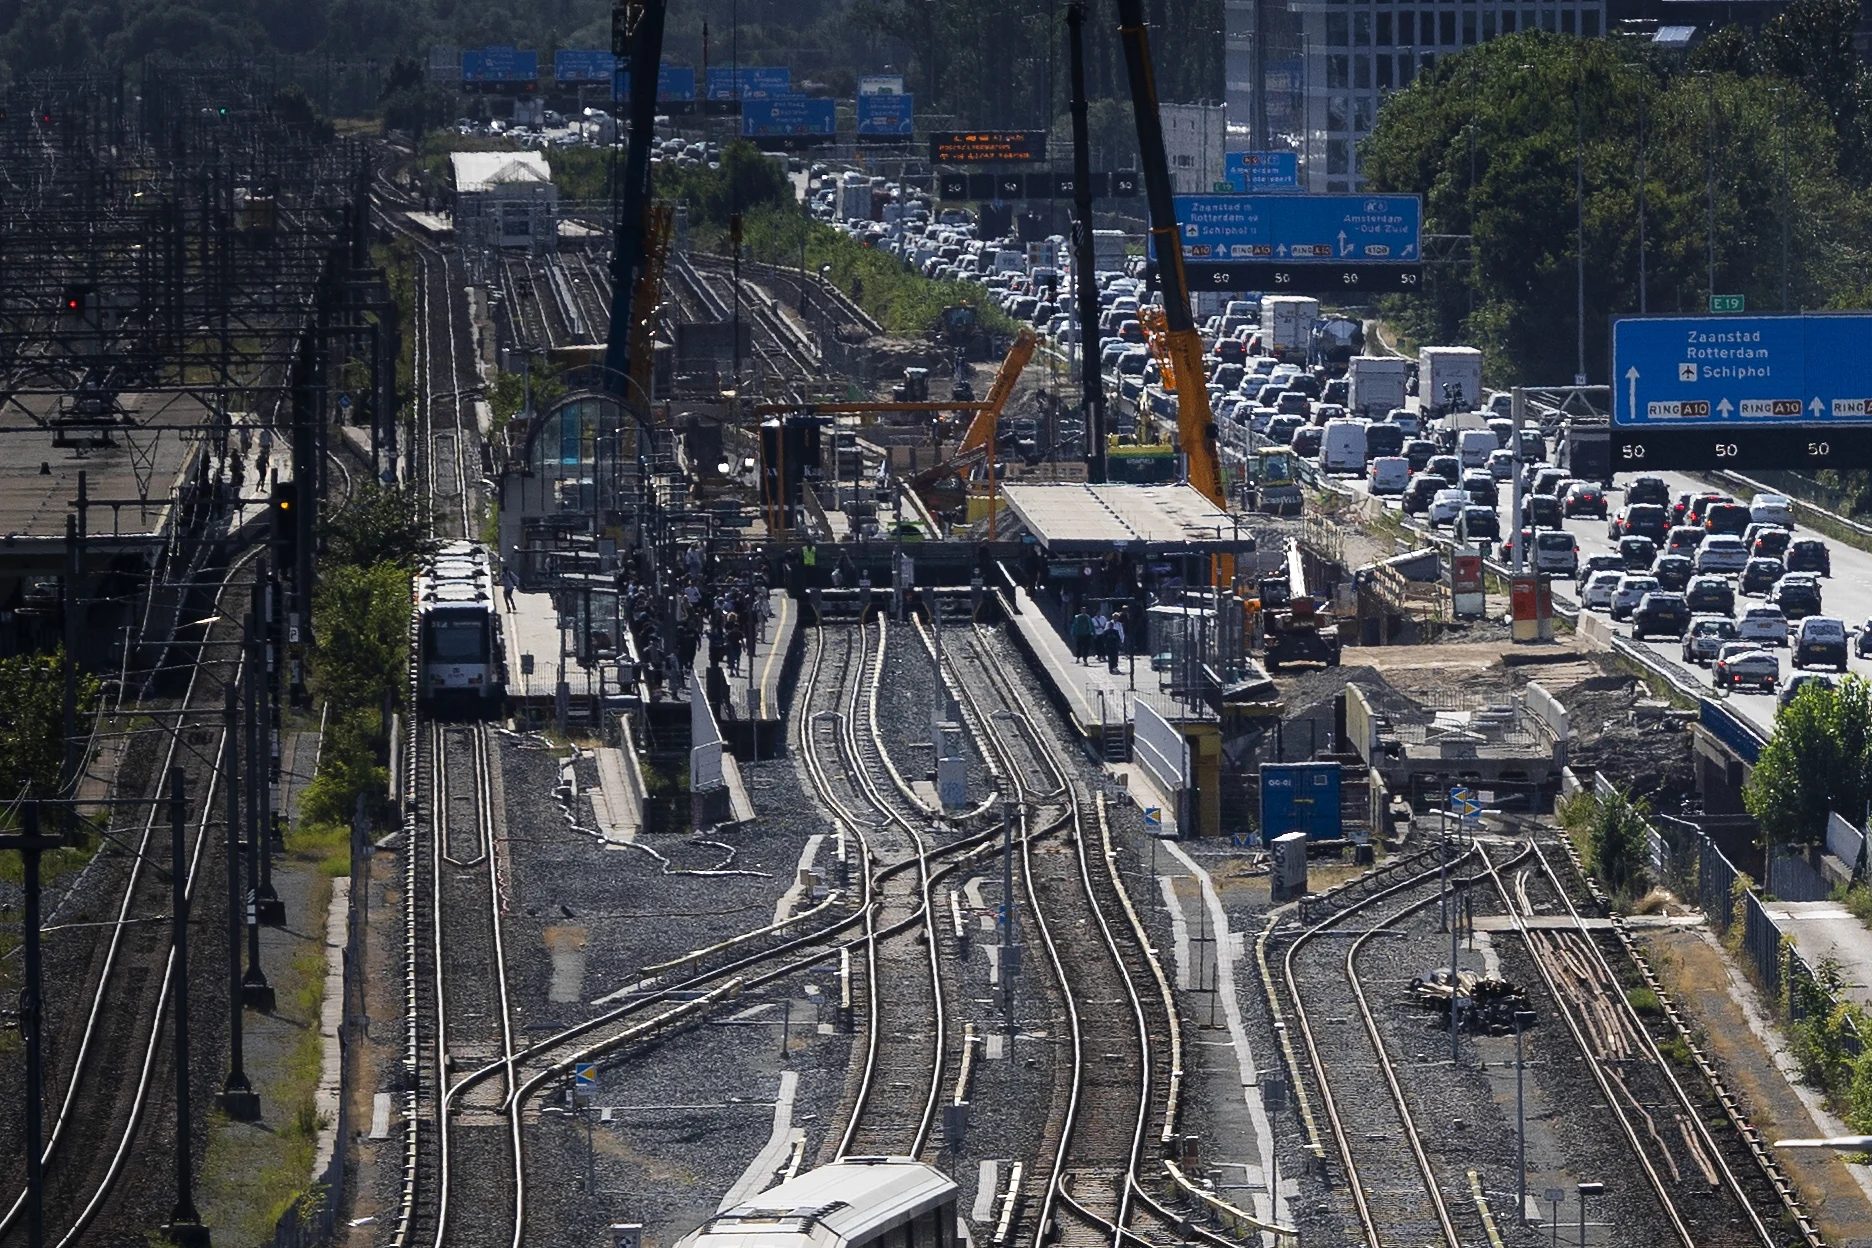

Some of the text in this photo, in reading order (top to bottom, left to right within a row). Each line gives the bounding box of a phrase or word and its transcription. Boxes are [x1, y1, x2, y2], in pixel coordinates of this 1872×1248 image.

[1192, 203, 1240, 211] Zaanstad
[1191, 214, 1244, 222] Rotterdam
[1344, 214, 1402, 223] Amsterdam
[1203, 226, 1247, 235] Schiphol
[1385, 225, 1408, 233] Zuid
[1213, 273, 1230, 283] 50
[1275, 273, 1290, 283] 50
[1401, 273, 1416, 284] 50
[1714, 299, 1739, 308] E 19
[1688, 331, 1760, 343] Zaanstad
[1687, 347, 1768, 359] Rotterdam
[1703, 365, 1771, 379] Schiphol
[1649, 404, 1707, 414] RING A10
[1742, 402, 1799, 413] RING A10
[1834, 402, 1863, 411] RING
[1622, 445, 1645, 458] 50
[1715, 444, 1738, 457] 50
[1808, 442, 1829, 455] 50
